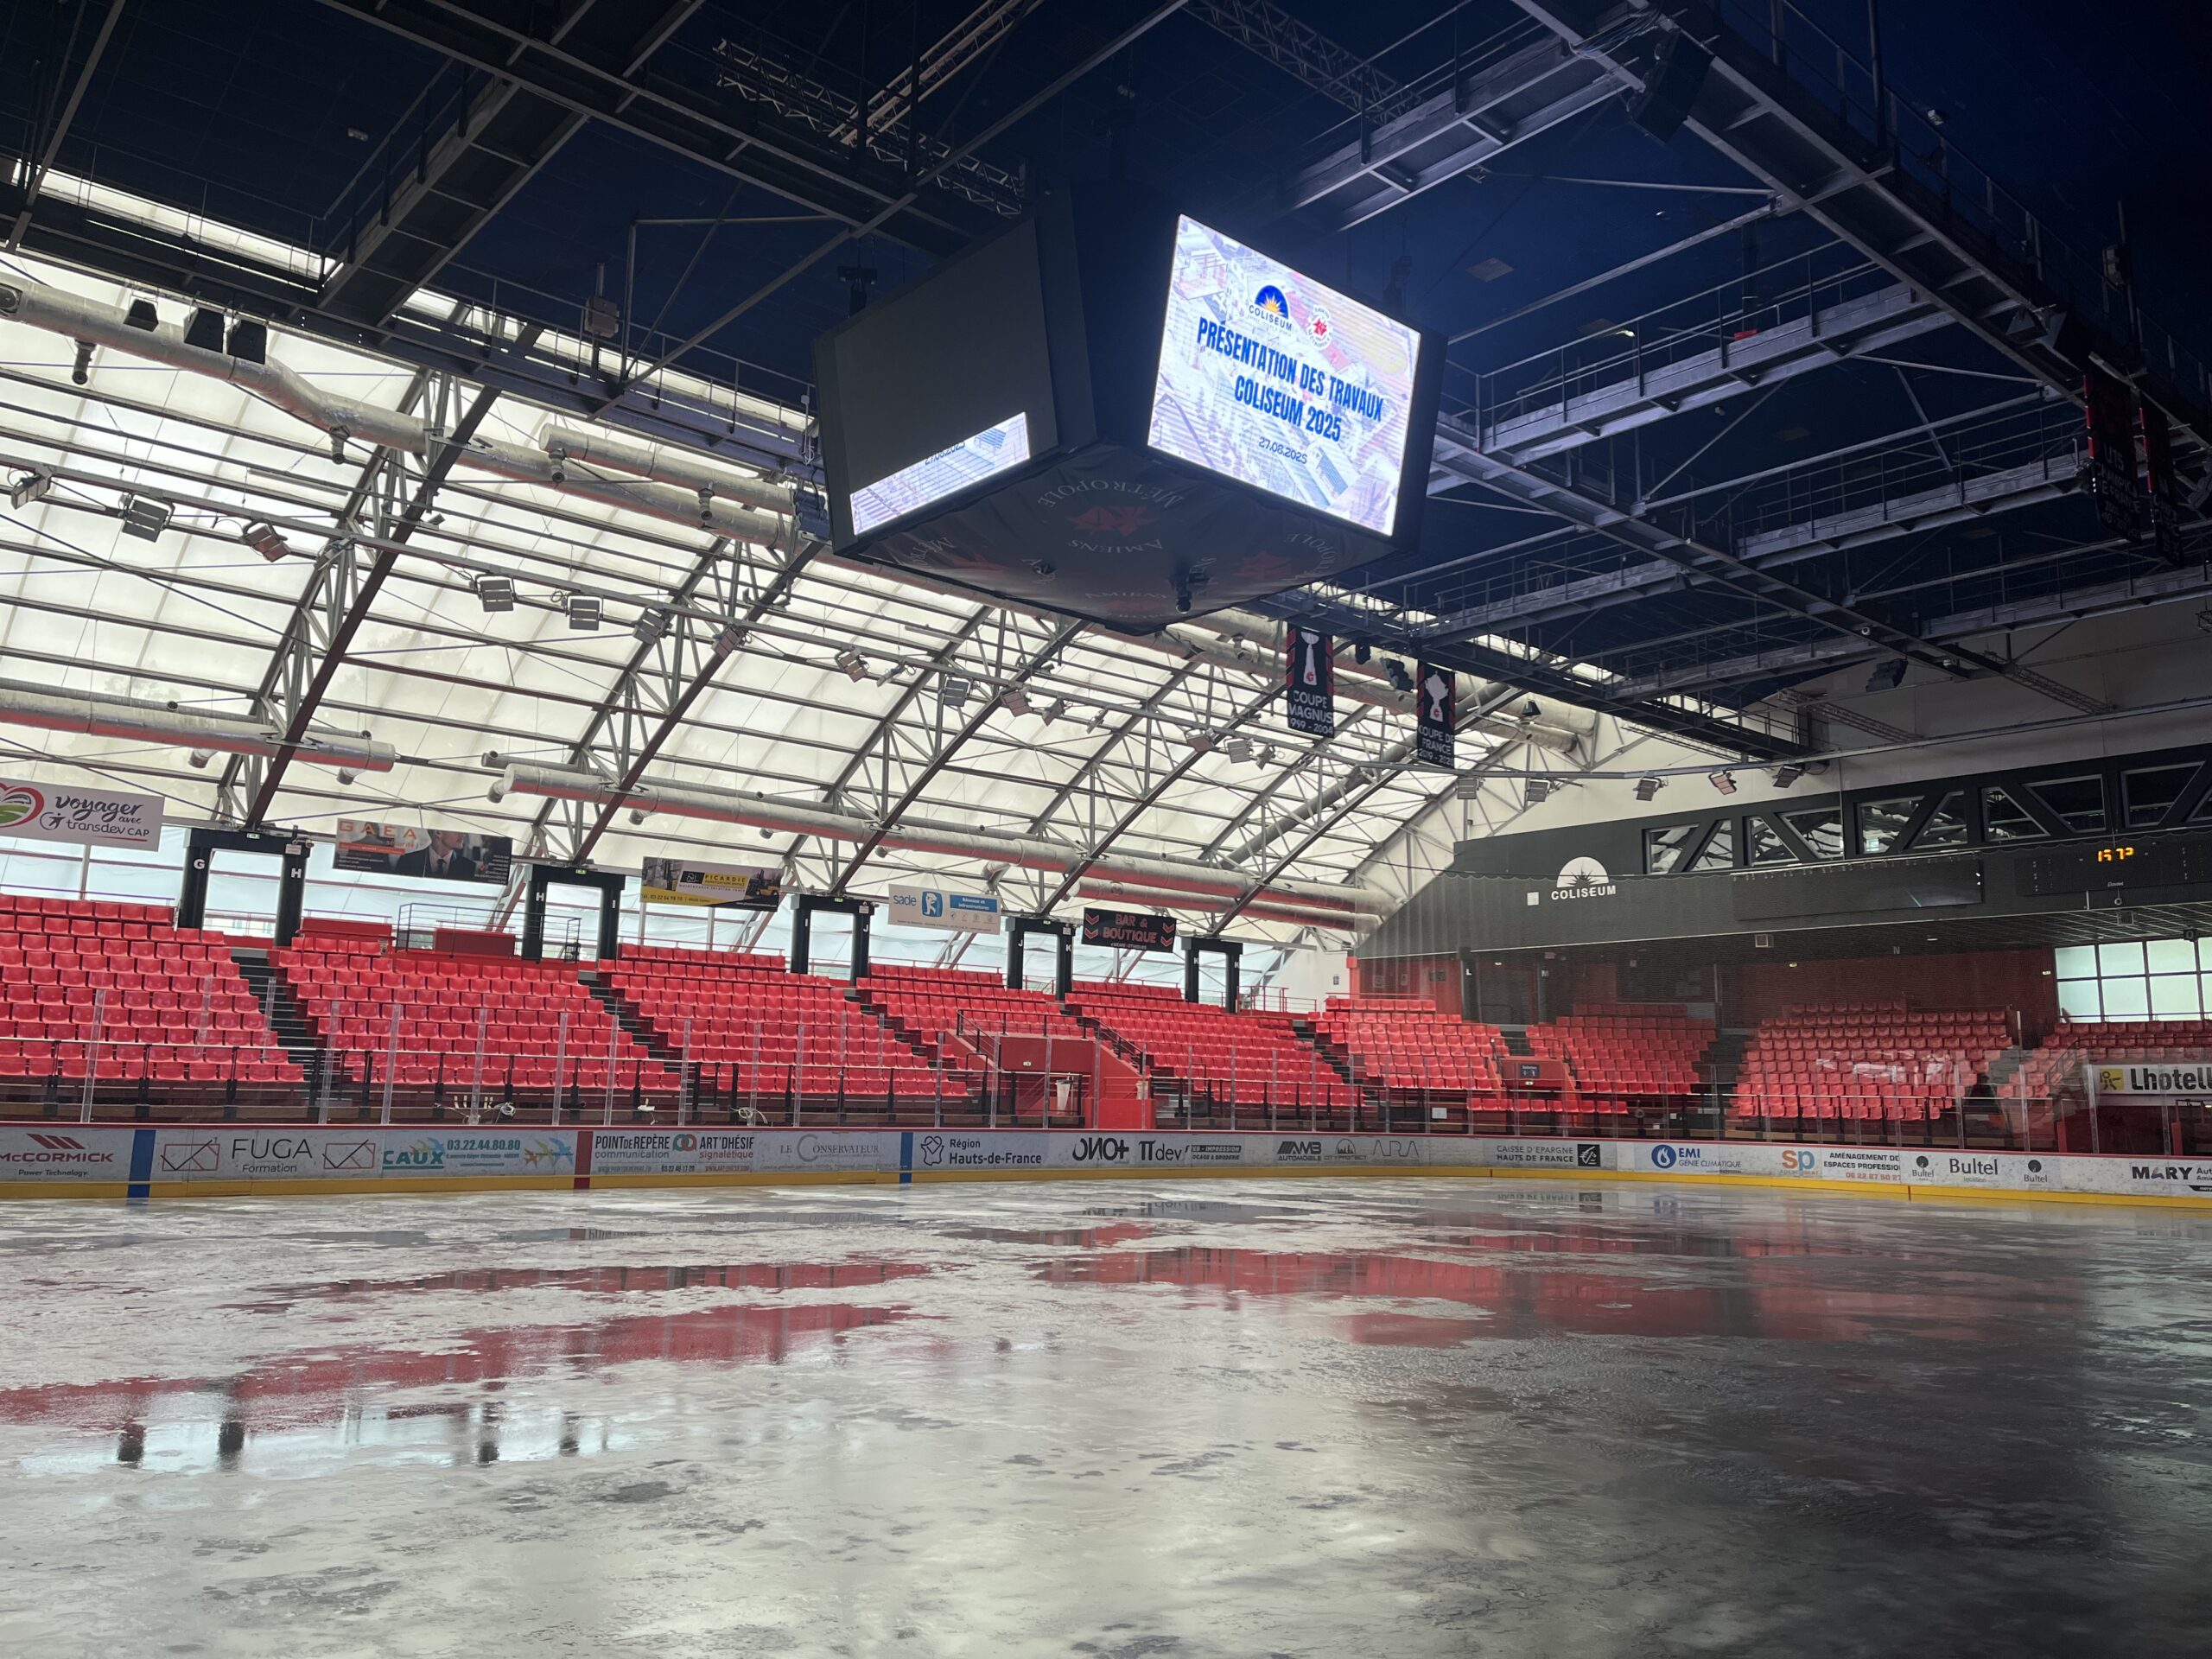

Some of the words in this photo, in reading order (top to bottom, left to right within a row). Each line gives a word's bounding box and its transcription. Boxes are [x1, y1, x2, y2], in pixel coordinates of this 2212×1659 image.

[1249, 304, 1293, 332] COLISEUM
[1197, 316, 1295, 385] PRÉSENTATION
[1300, 363, 1325, 396] DES
[1329, 376, 1383, 422] TRAVAUX
[1235, 376, 1304, 427] COLISEUM
[1306, 407, 1341, 442] 2025
[1259, 436, 1307, 465] 27.08.2025
[1294, 690, 1327, 709] COUPE
[1290, 717, 1306, 729] 999
[1313, 723, 1333, 734] 2004
[1418, 724, 1444, 741] COUPE
[1422, 737, 1452, 755] FRANCE
[55, 795, 143, 822] voyager
[118, 816, 142, 824] avec
[67, 819, 124, 835] transdev
[127, 828, 150, 837] CAP
[338, 820, 417, 839] GAEA
[194, 859, 205, 869] G
[290, 868, 302, 878] H
[705, 874, 747, 883] PICARDIE
[536, 892, 544, 901] H
[893, 894, 917, 906] sade
[1551, 885, 1617, 900] COLISEUM
[1115, 913, 1136, 926] BAR
[1140, 918, 1147, 928] &
[1103, 926, 1158, 943] BOUTIQUE
[232, 1138, 313, 1160] FUGA
[447, 1139, 521, 1151] 03.22.44.80.80
[699, 1135, 755, 1150] ART'DHÉSIF
[780, 1145, 792, 1154] LE
[797, 1134, 880, 1162] CONSERVATEUR
[950, 1139, 981, 1150] Région
[1497, 1145, 1524, 1154] CAISSE
[383, 1150, 444, 1166] CAUX
[595, 1150, 670, 1159] communication
[699, 1150, 753, 1160] signalétique
[949, 1153, 1042, 1165] Hauts-de-France
[1679, 1147, 1700, 1159] EMI
[1782, 1150, 1815, 1171] sp
[1829, 1152, 1888, 1161] AMÉNAGEMENT
[242, 1164, 297, 1173] Formation
[1912, 1169, 1935, 1178] Bultel
[1949, 1158, 1999, 1175] Bultel
[2024, 1173, 2048, 1183] Bultel
